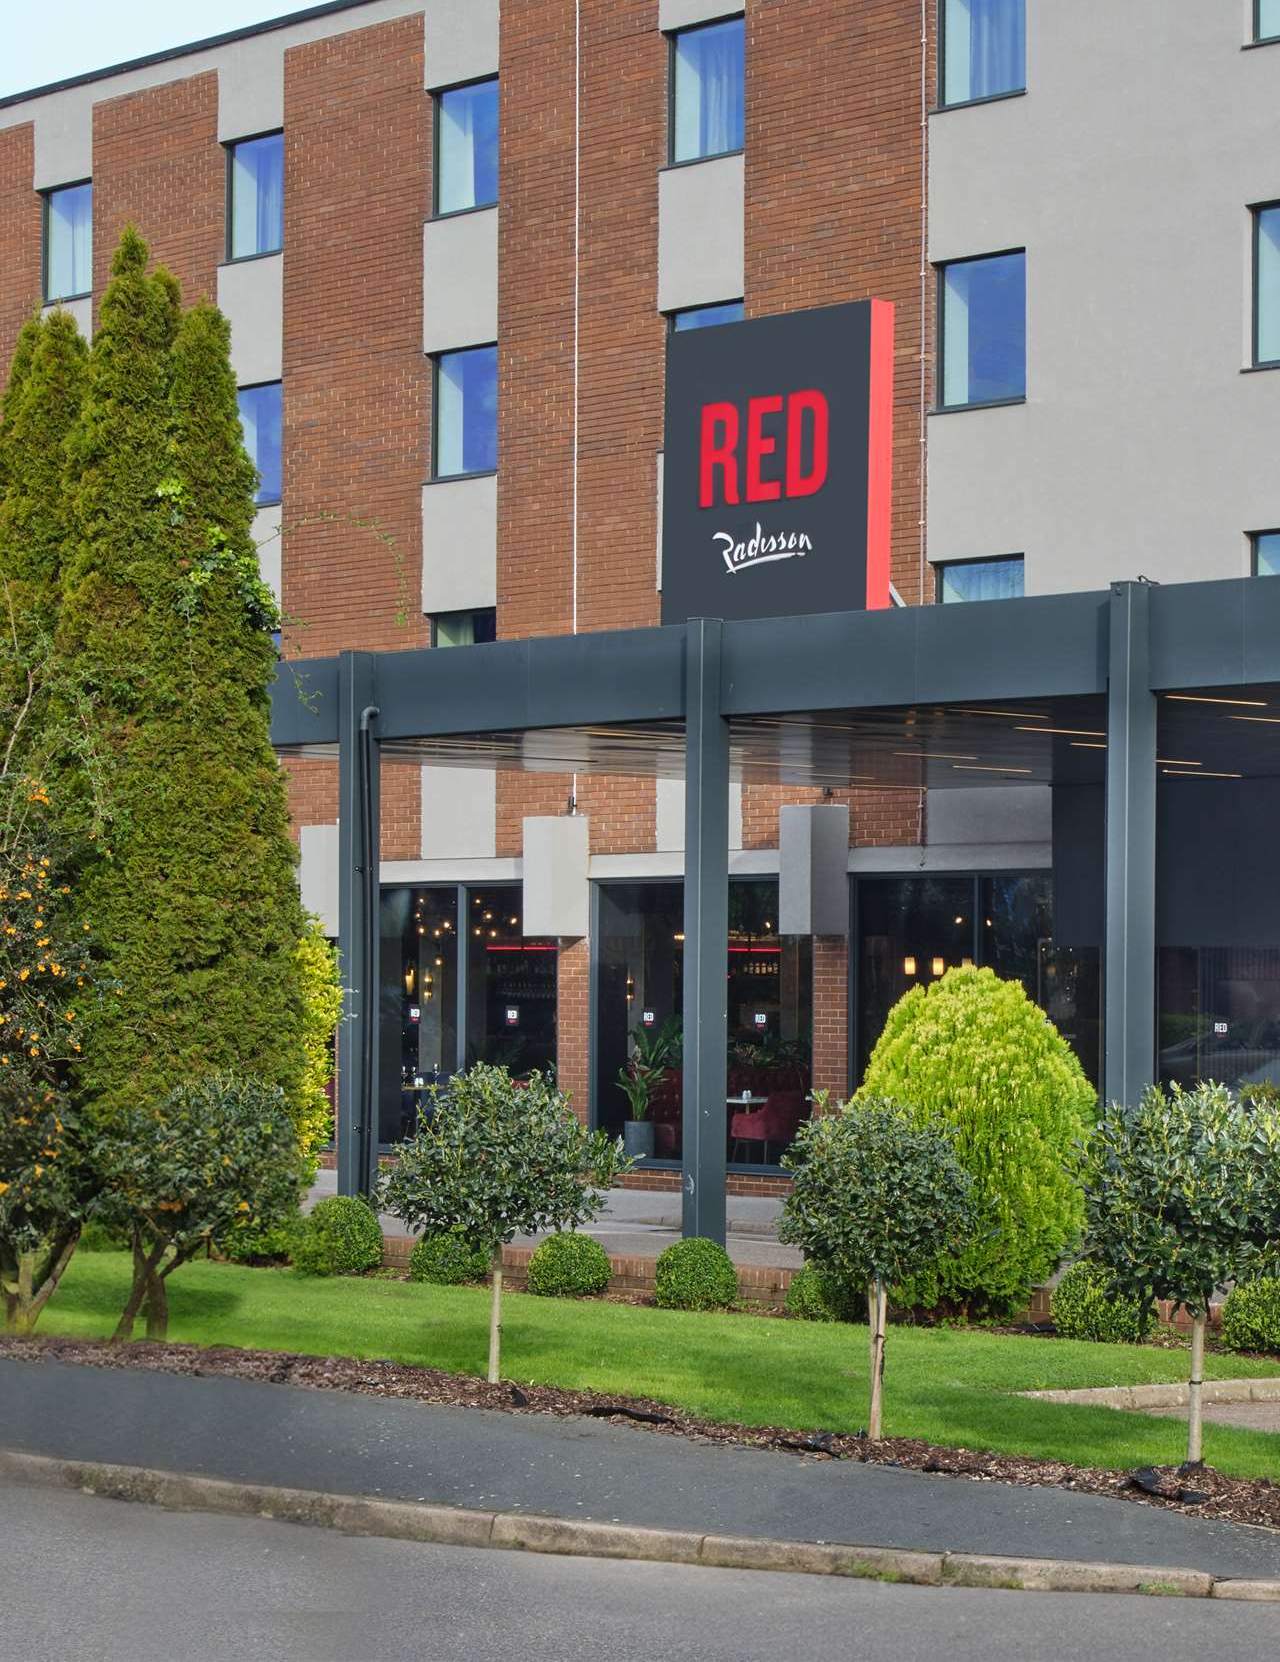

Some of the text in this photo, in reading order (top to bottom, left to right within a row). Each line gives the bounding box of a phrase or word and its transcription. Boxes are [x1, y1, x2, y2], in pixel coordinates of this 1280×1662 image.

[699, 389, 829, 508] RED
[712, 521, 813, 574] Radisson
[1214, 1022, 1228, 1033] RED
